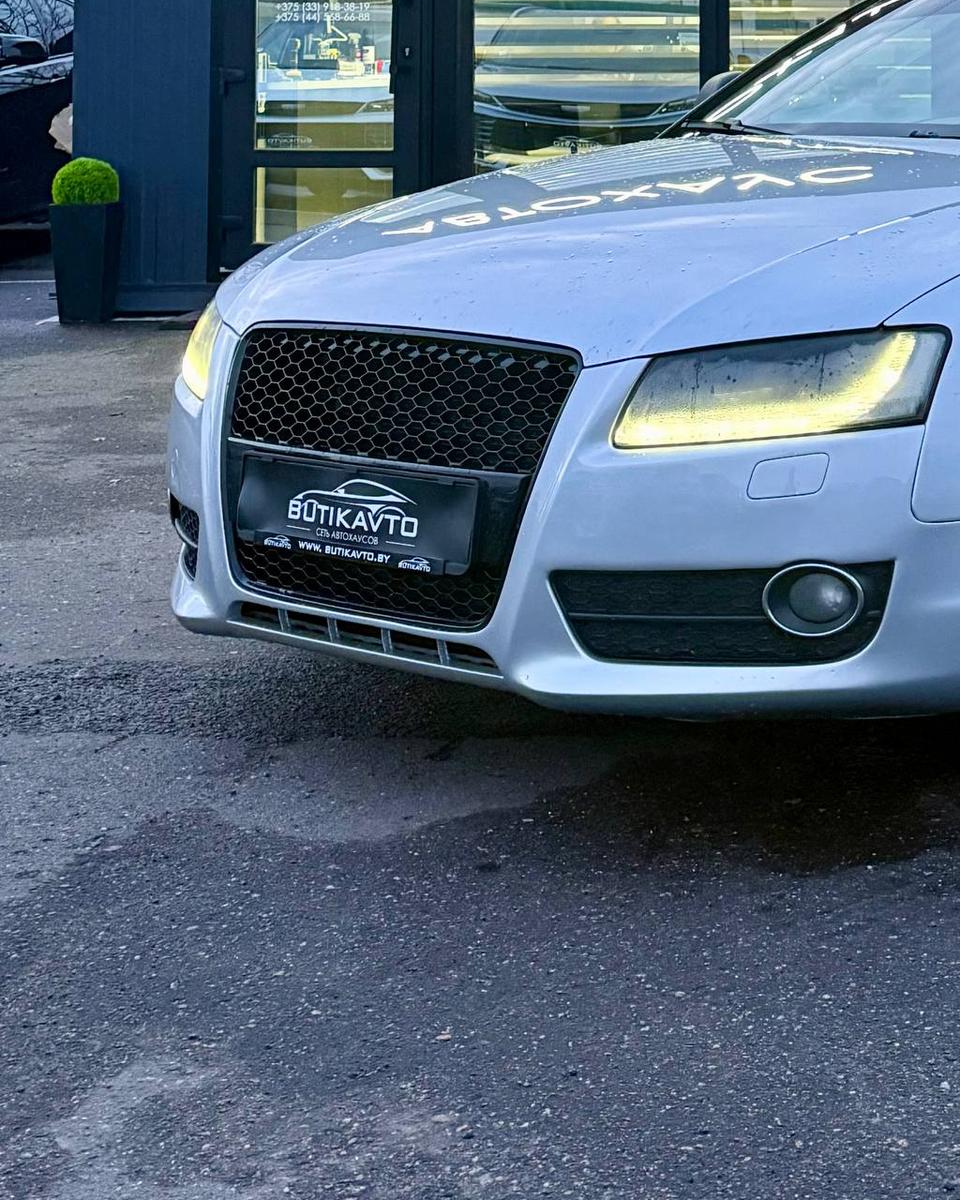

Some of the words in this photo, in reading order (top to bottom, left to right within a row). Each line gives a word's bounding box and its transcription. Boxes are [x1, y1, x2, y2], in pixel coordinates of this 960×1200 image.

[275, 2, 300, 11] +375
[302, 1, 320, 13] (33)
[302, 12, 320, 23] (44)
[287, 499, 419, 538] BUTIKAVTO
[315, 527, 331, 538] СЕТЬ
[330, 531, 379, 546] АВТОХАУСОВ
[298, 540, 322, 553] WWW.
[324, 545, 391, 563] BUTIKAVTO.BY
